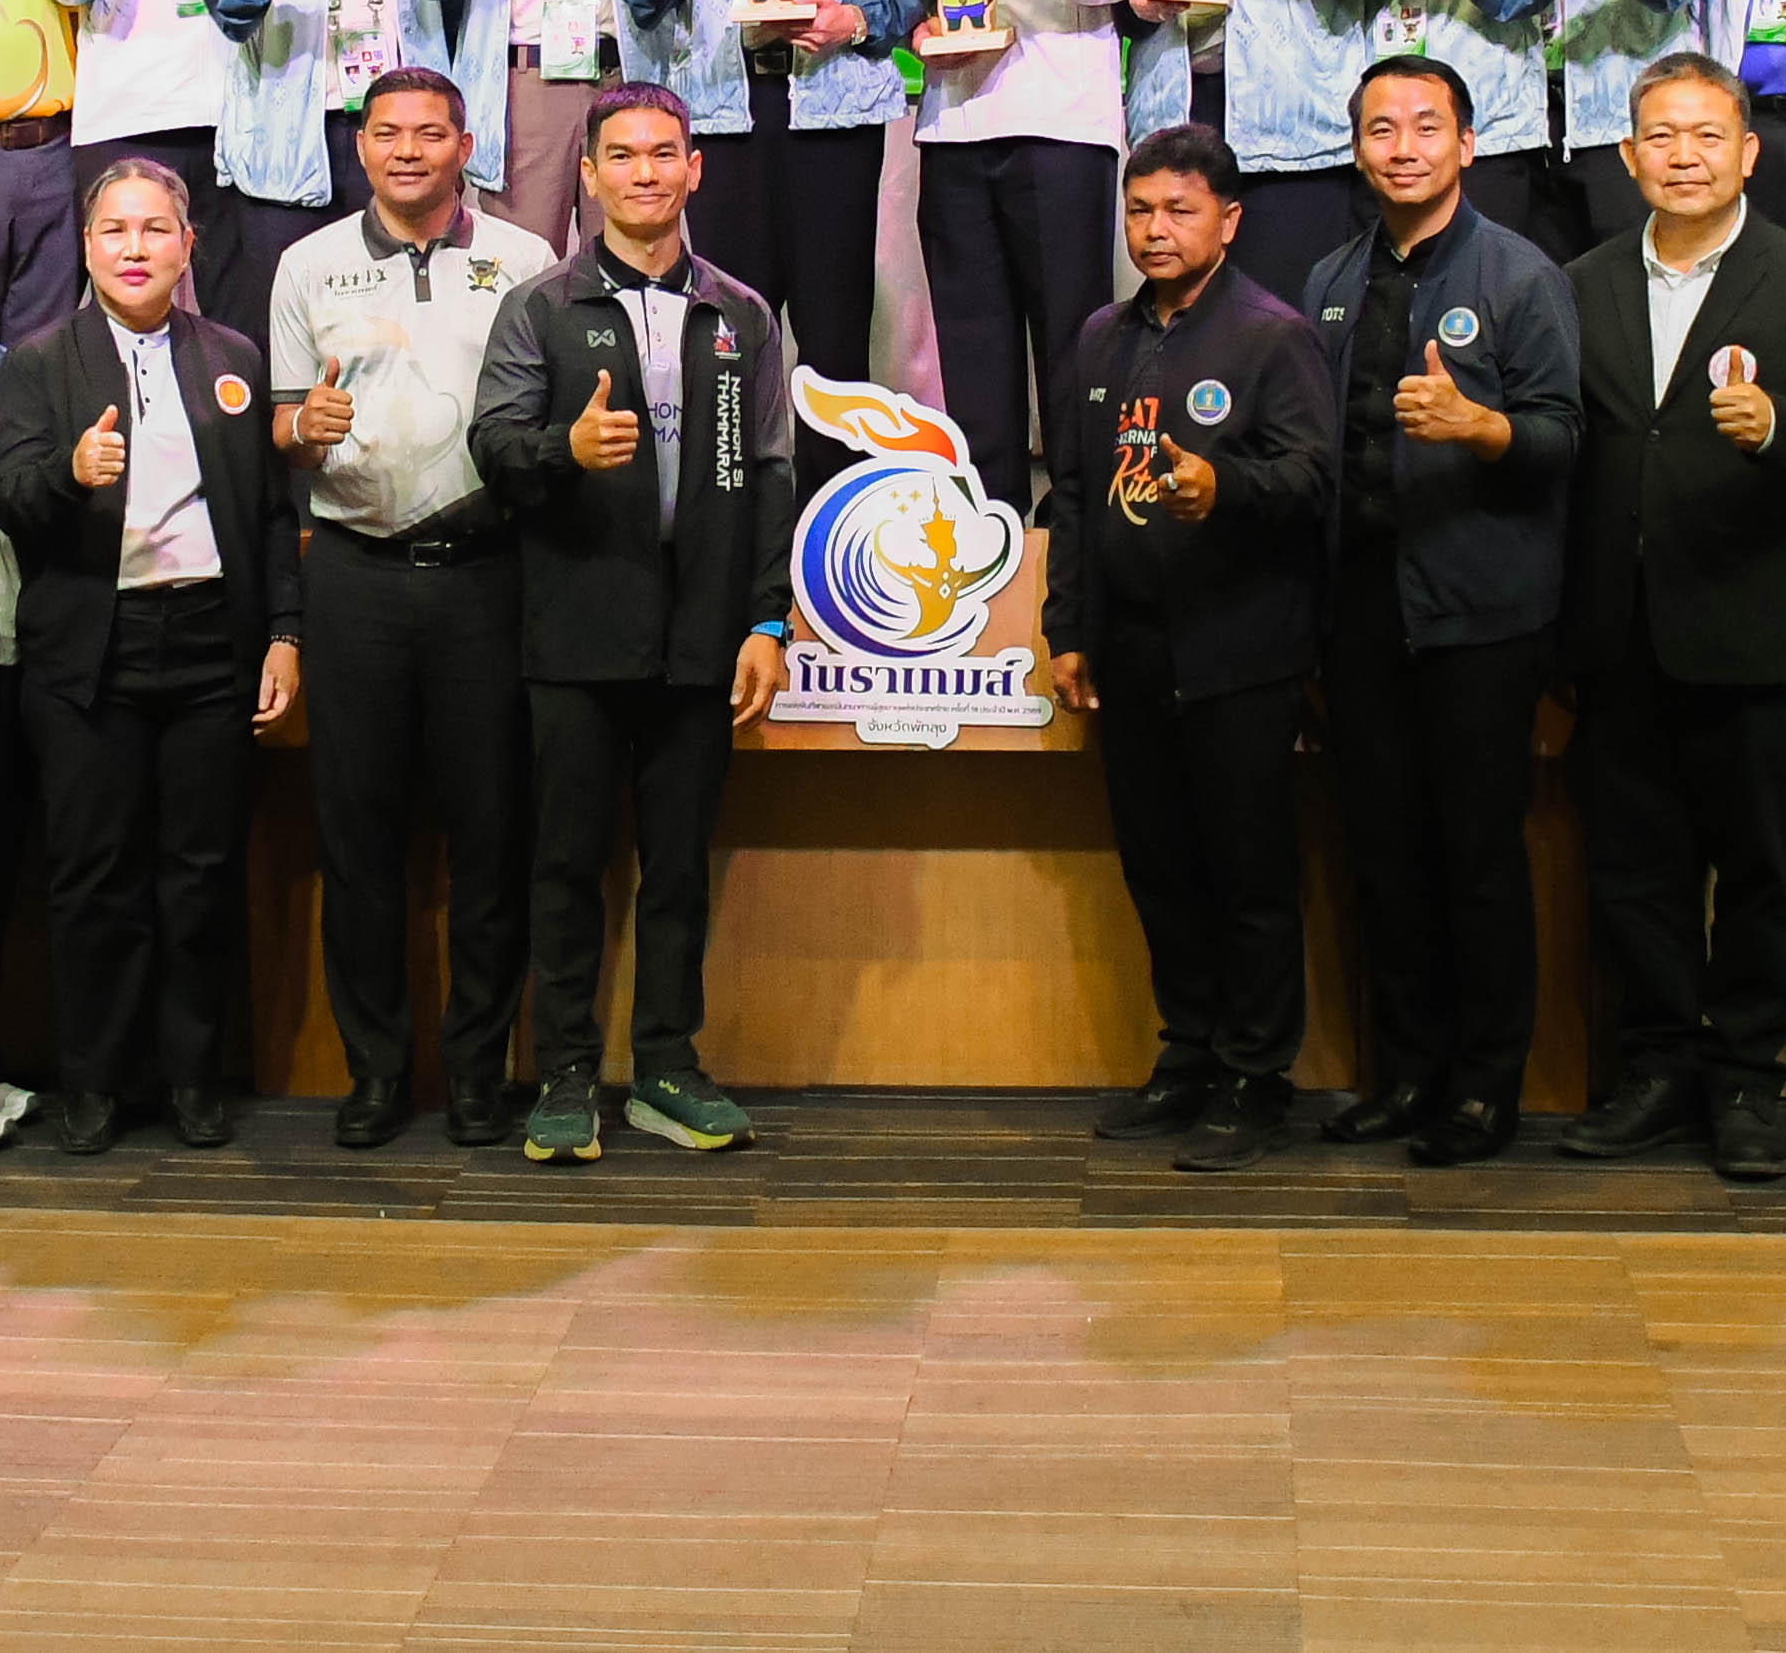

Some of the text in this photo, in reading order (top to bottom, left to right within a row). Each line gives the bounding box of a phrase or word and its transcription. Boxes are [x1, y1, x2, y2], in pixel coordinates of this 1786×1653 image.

[716, 369, 731, 492] THAMMARAT
[730, 375, 744, 488] NAKHON SI
[797, 652, 1023, 696] โนราเกมส์
